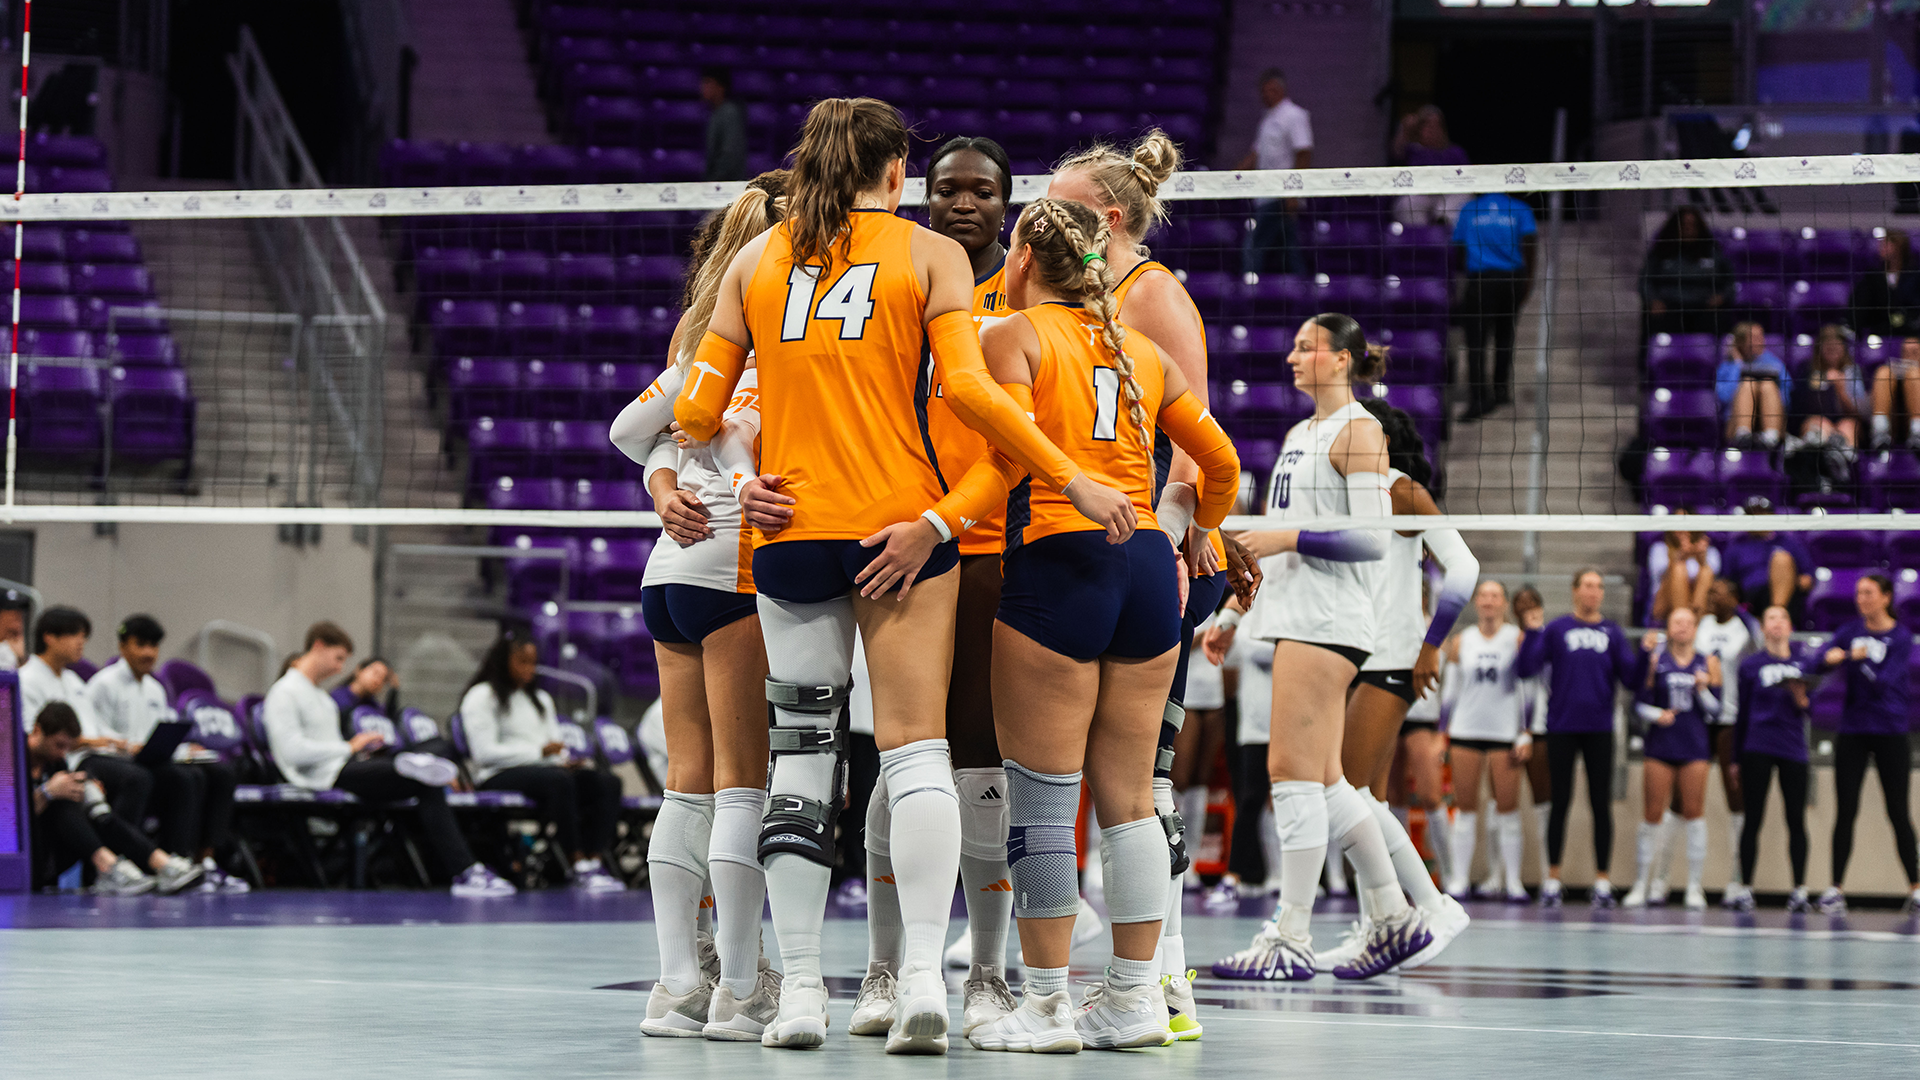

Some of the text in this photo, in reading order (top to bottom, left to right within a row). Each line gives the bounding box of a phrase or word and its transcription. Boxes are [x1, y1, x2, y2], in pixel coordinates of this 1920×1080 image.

[780, 262, 880, 343] 14
[1092, 365, 1120, 442] 1
[1271, 473, 1292, 509] 10
